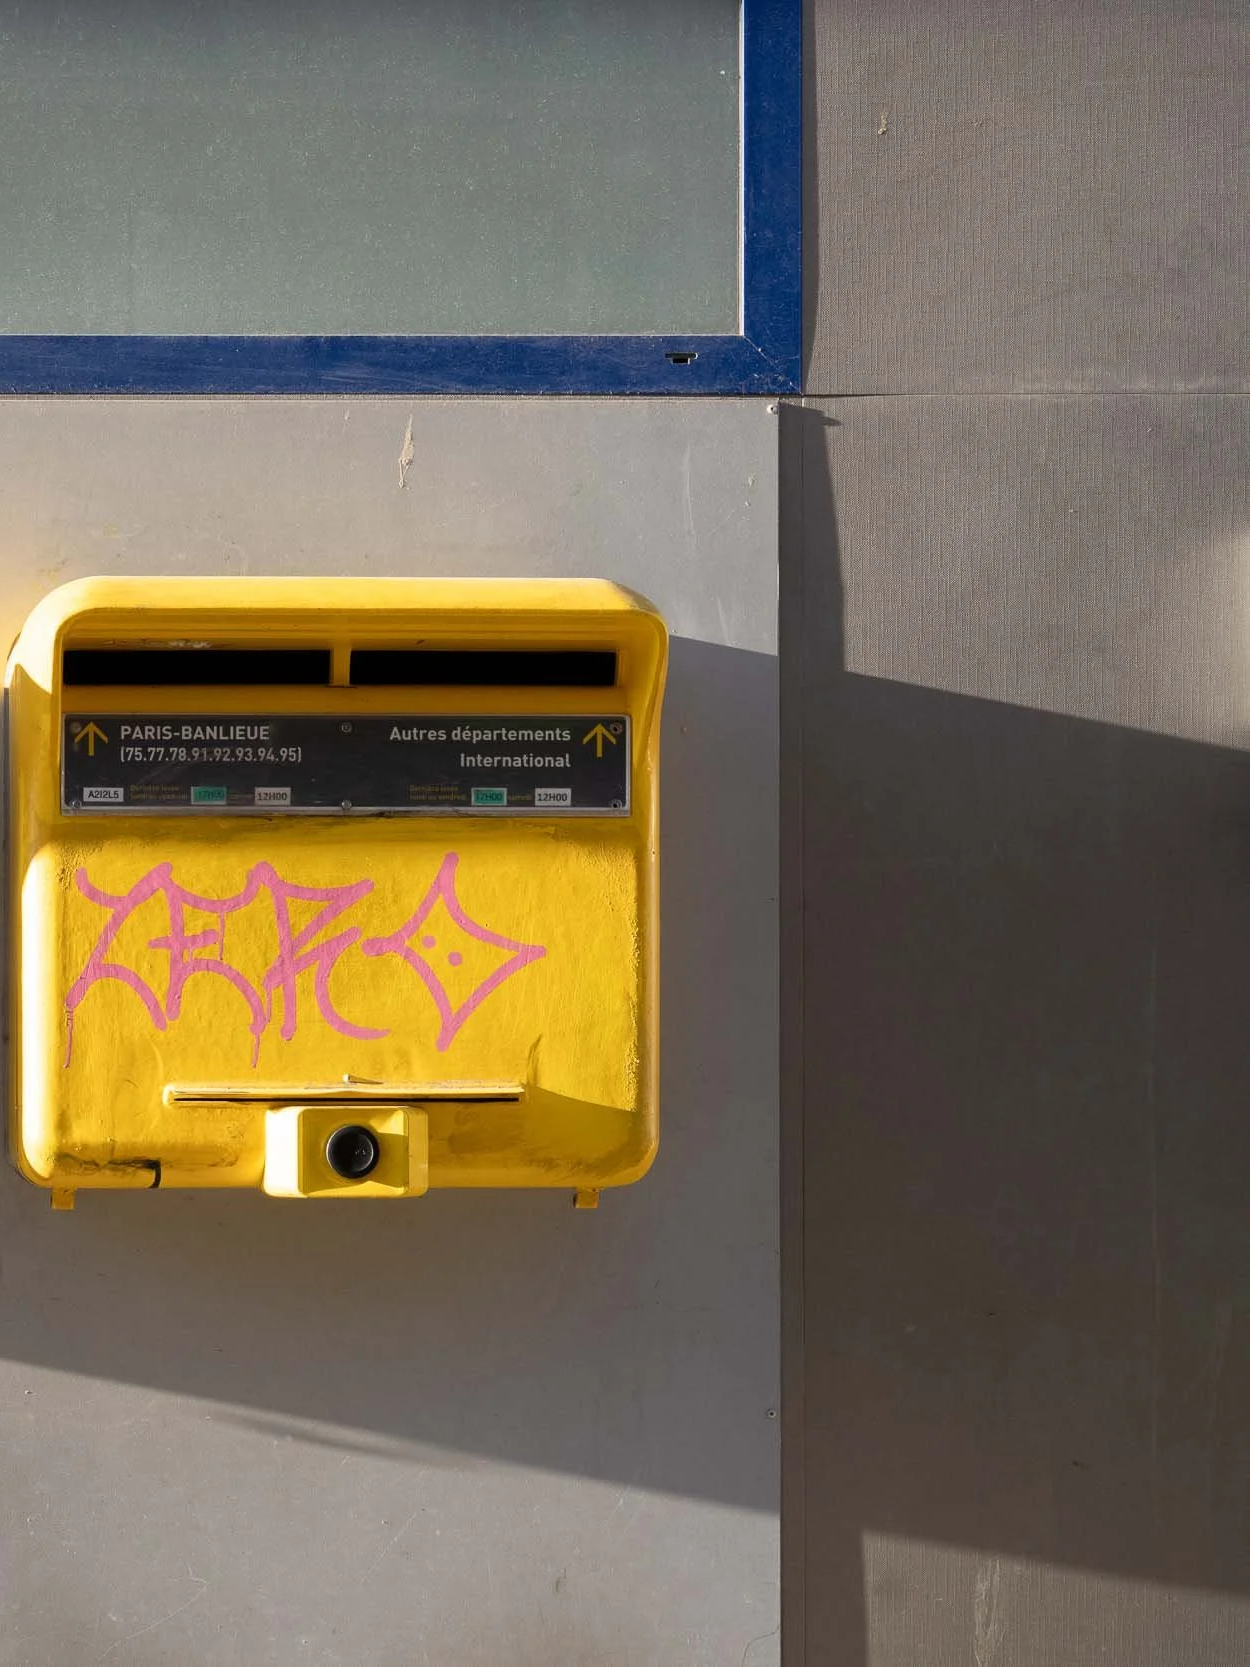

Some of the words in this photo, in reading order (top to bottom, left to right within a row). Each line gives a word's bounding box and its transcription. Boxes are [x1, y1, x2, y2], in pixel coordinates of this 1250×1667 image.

[121, 726, 270, 740] PARIS-BANLIEUE
[390, 727, 447, 741] Autres
[451, 726, 571, 744] départements
[460, 753, 571, 768] International
[257, 792, 288, 801] 12H00
[537, 792, 568, 802] 12H00
